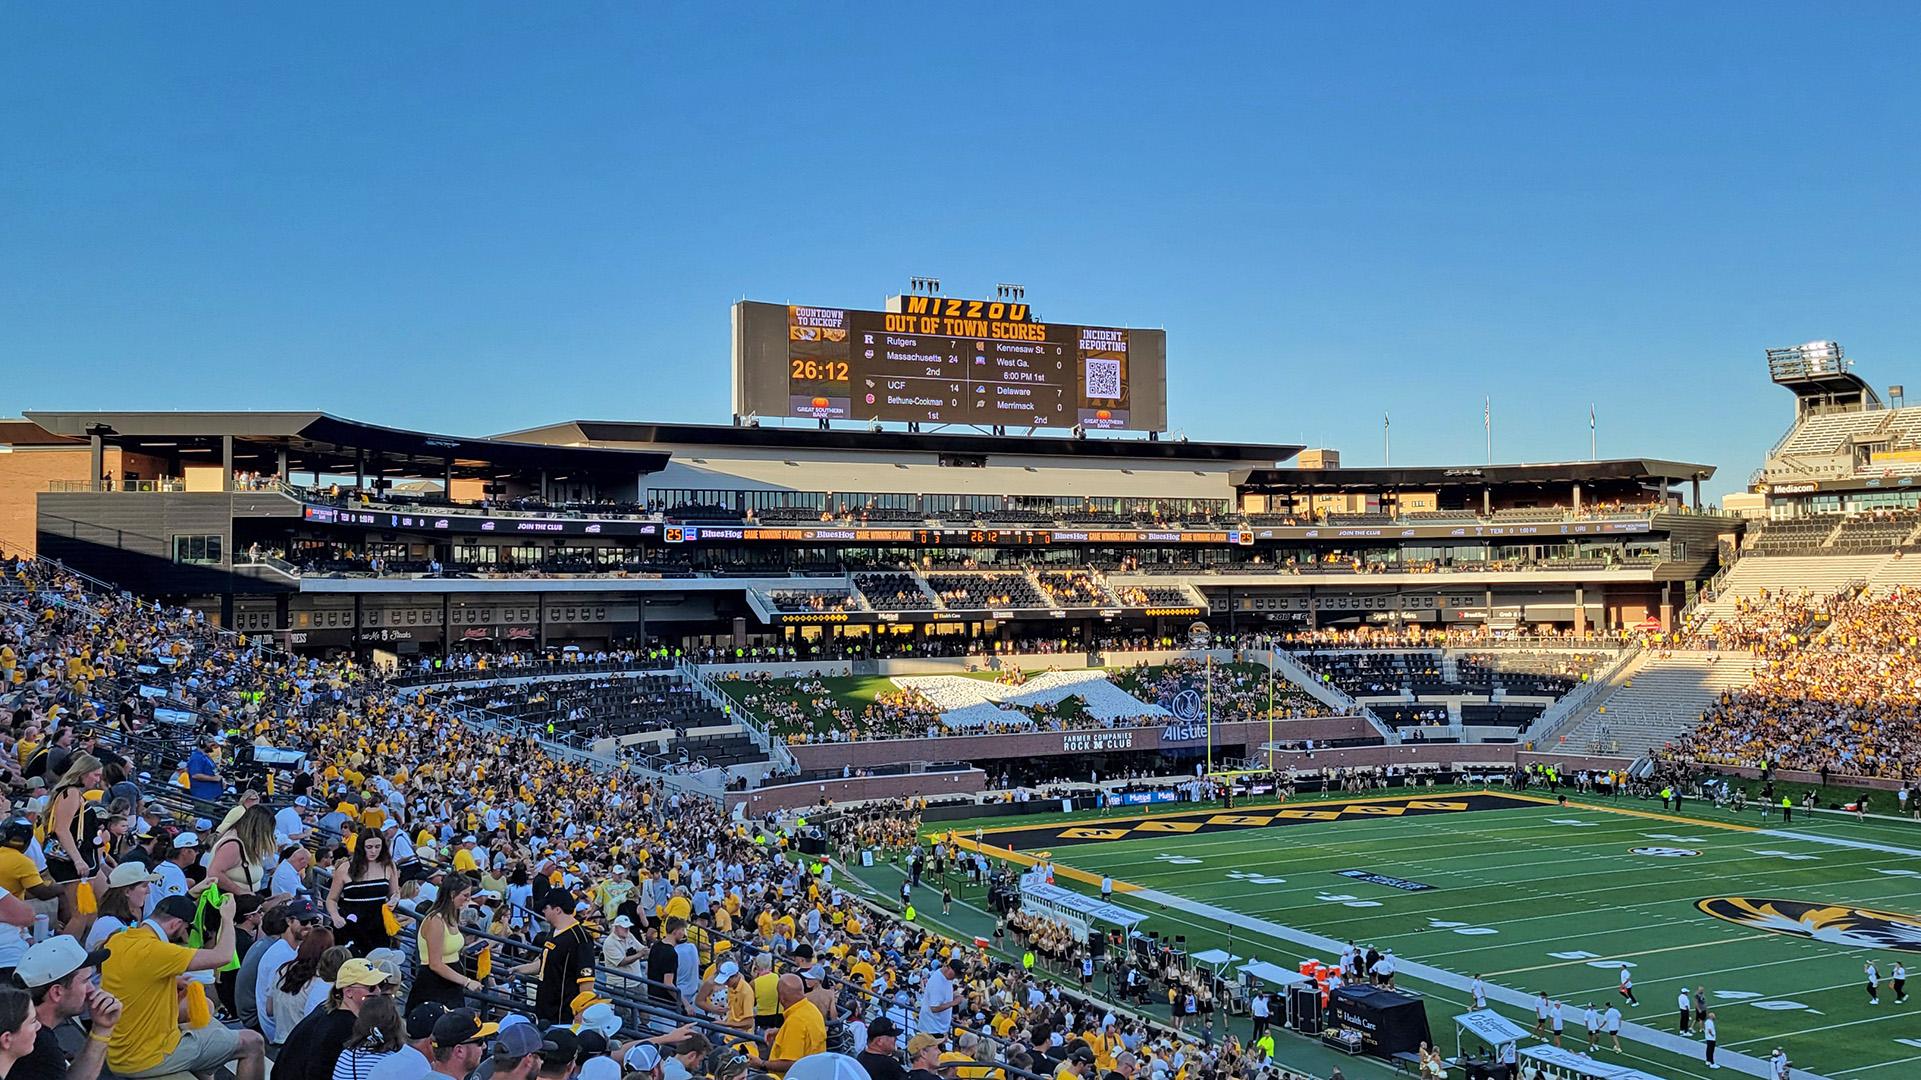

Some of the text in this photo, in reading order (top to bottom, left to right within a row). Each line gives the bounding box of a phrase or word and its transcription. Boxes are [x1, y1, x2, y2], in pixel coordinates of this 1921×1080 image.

[796, 308, 844, 319] COUNTDOWN
[908, 297, 1026, 320] MIZZOU
[797, 317, 843, 327] TO KICKOFF
[885, 314, 1046, 341] OUT OF TOWN SCORES
[1083, 329, 1123, 342] INCIDENT
[887, 337, 917, 347] Rutgers
[1079, 339, 1126, 352] REPORTING
[996, 344, 1061, 355] Kennesaw St. 0
[887, 352, 942, 363] Massachusetts
[996, 358, 1061, 369] West Ga. 0
[791, 360, 849, 381] 26:12
[926, 367, 941, 376] 2nd
[1003, 372, 1044, 382] 6:00 PM 1st
[887, 381, 959, 392] UCF 14
[997, 387, 1062, 397] Delaware 7
[887, 396, 957, 407] Bethune-Cookman 0
[997, 401, 1062, 411] Merrimack 0
[927, 411, 939, 420] 1st
[1034, 416, 1047, 424] 2nd
[1774, 485, 1814, 494] Mediacom
[535, 523, 546, 531] THE
[667, 529, 681, 541] 25
[782, 530, 802, 540] FLAVOR
[893, 531, 911, 540] FLAVOR
[921, 534, 926, 543] 0
[1045, 535, 1050, 544] 0
[1063, 732, 1132, 743] FARMER COMPANIES
[1063, 741, 1090, 751] ROCK
[1107, 739, 1132, 749] CLUB
[1344, 1011, 1362, 1026] Health
[1362, 1018, 1377, 1030] Care
